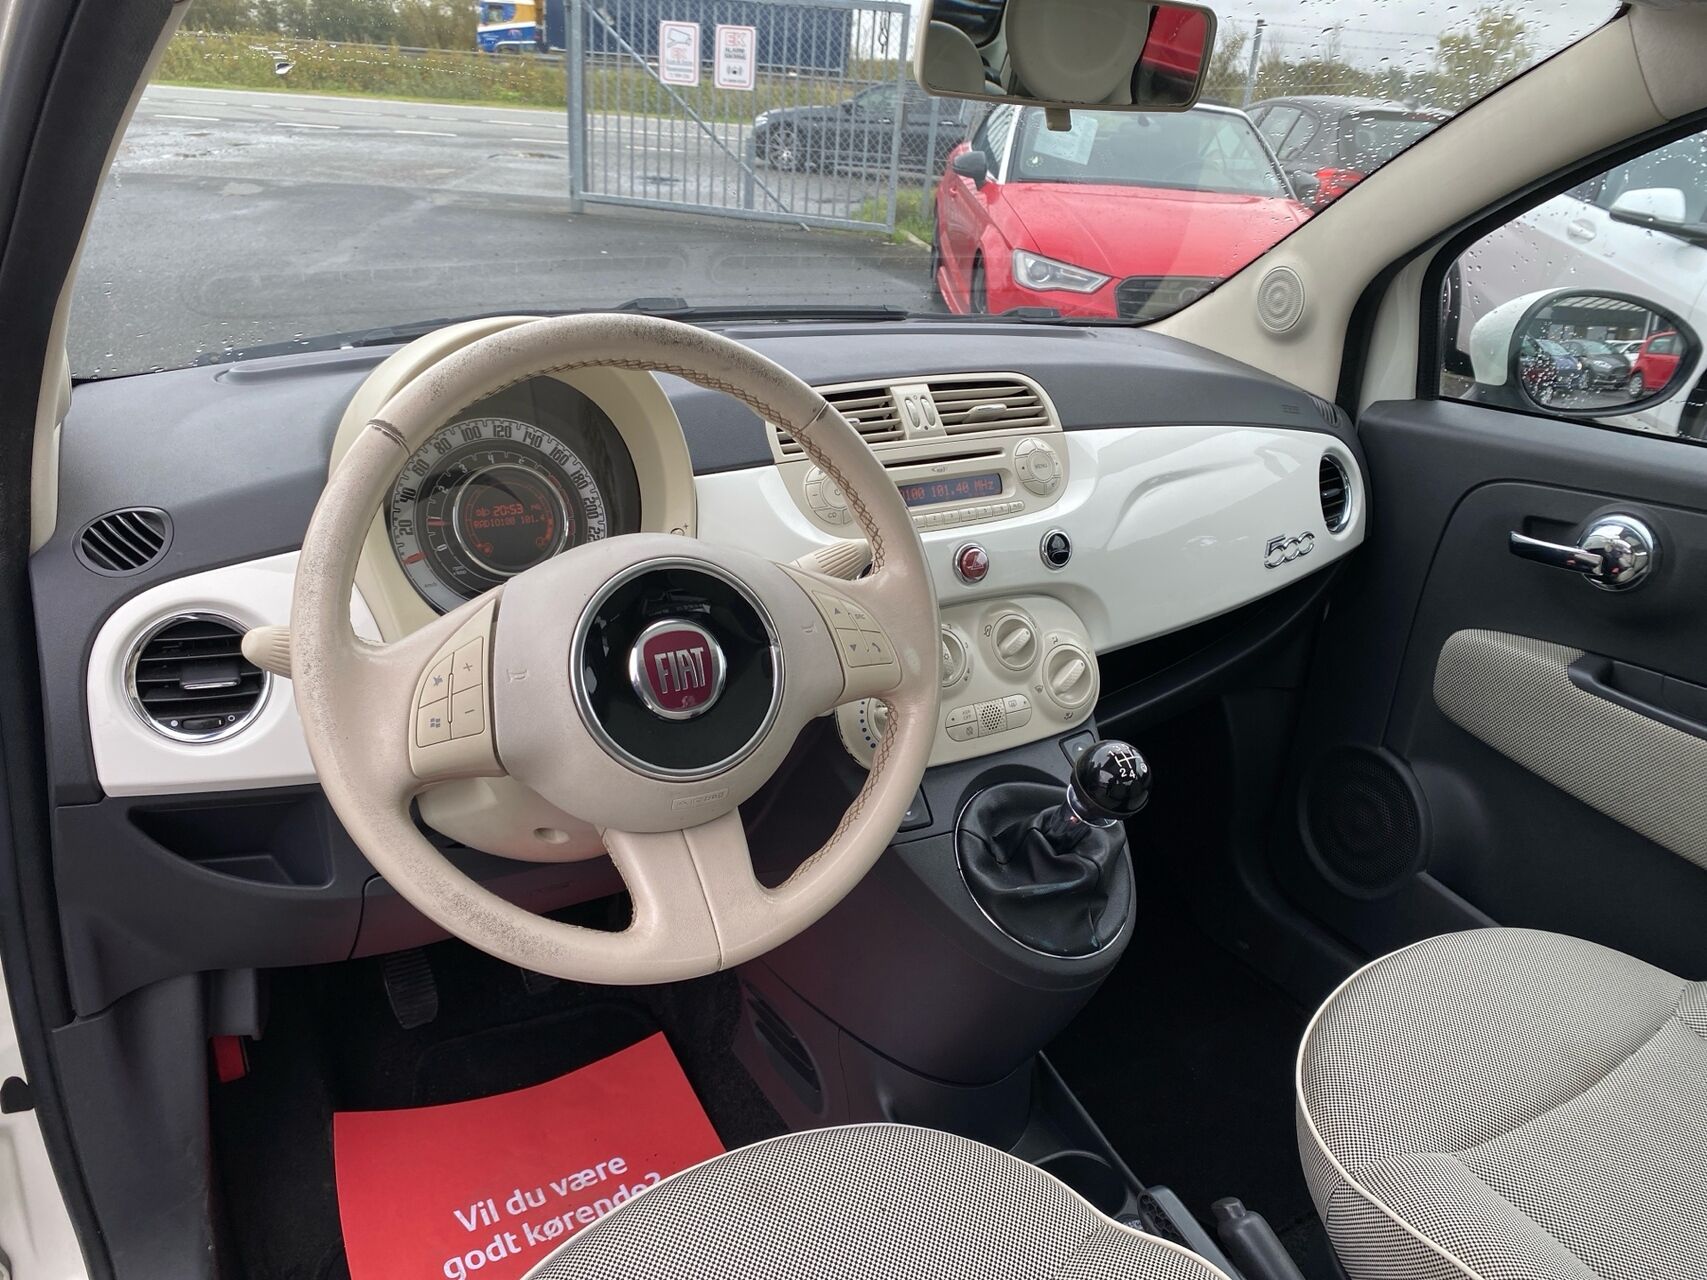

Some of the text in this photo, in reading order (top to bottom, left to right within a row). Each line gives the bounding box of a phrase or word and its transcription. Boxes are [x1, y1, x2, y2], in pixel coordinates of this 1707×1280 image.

[461, 426, 481, 442] 100
[493, 425, 512, 438] 120
[523, 430, 543, 448] 140
[433, 438, 452, 454] 80
[549, 447, 569, 466] 160
[412, 459, 430, 476] 60
[570, 470, 589, 489] 180
[400, 487, 416, 503] 40
[931, 482, 969, 498] 101.40
[493, 504, 524, 517] 20:53
[584, 497, 599, 520] 200
[398, 520, 414, 535] 20
[1264, 531, 1315, 569] 500
[654, 647, 706, 694] FIAT
[1120, 768, 1136, 778] 2 4
[453, 1156, 628, 1232] Vil du være
[443, 1172, 662, 1280] godt kørende?
